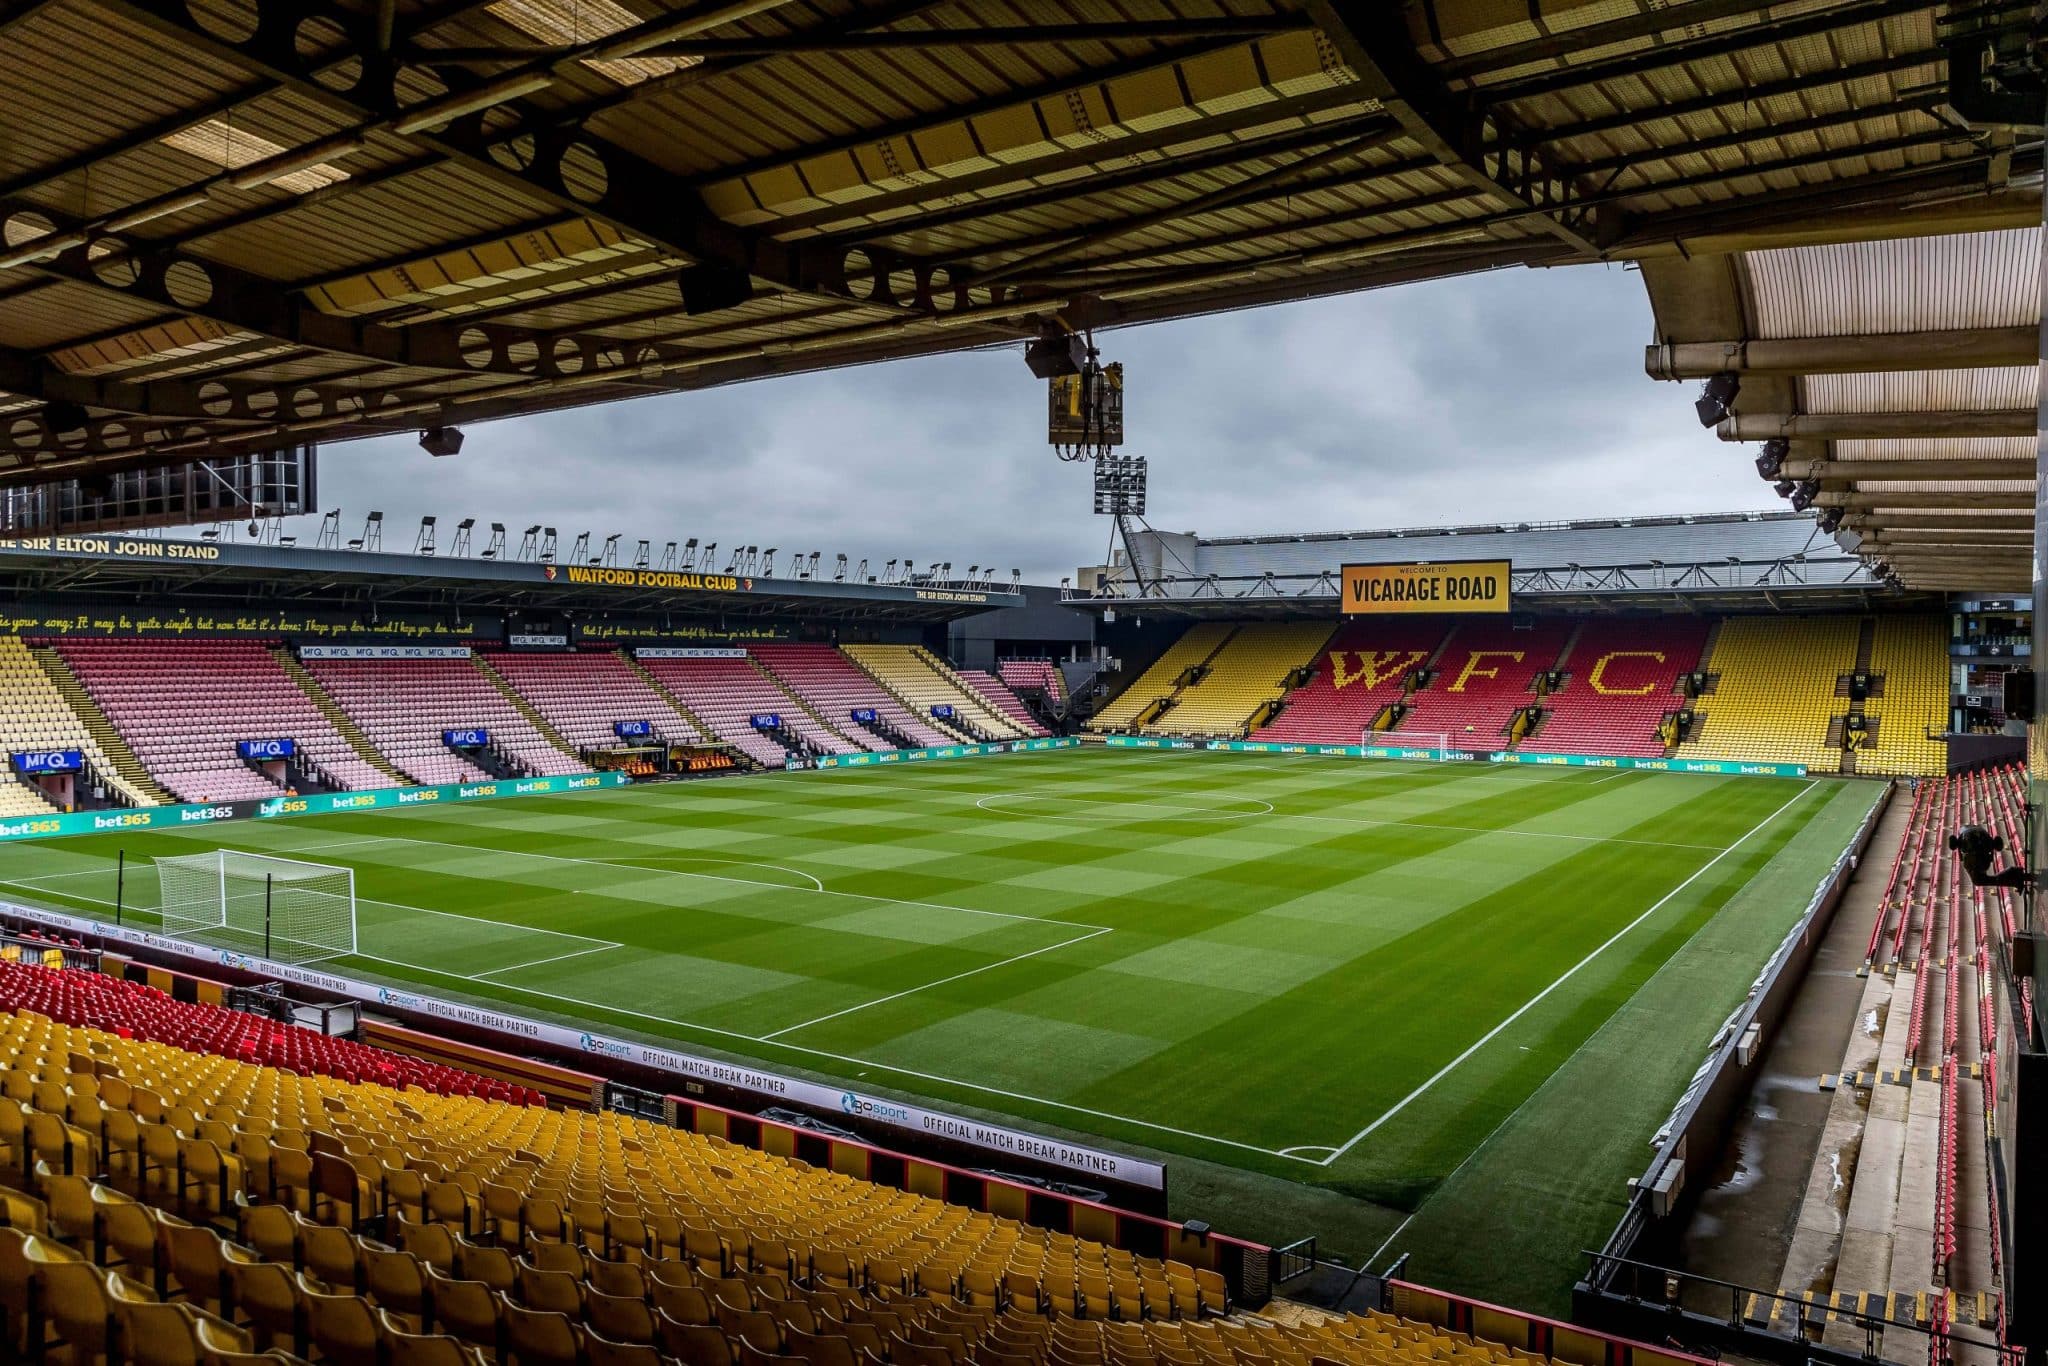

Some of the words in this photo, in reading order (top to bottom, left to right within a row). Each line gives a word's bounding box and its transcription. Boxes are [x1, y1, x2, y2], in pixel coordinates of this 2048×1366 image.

[22, 538, 51, 550] SIR
[57, 538, 110, 554] ELTON
[114, 541, 163, 557] JOHN
[168, 545, 219, 560] STAND
[568, 567, 635, 585] WATFORD
[639, 570, 703, 588] FOOTBALL
[706, 576, 737, 590] CLUB
[1353, 577, 1440, 602] VICARAGE
[1446, 576, 1496, 601] ROAD
[916, 591, 927, 599] THE
[928, 592, 937, 600] SIR
[938, 592, 954, 600] ELTON
[954, 592, 970, 601] JOHN
[970, 593, 987, 602] STAND
[12, 620, 39, 632] your
[76, 616, 88, 629] It
[94, 620, 116, 634] may
[120, 615, 132, 628] be
[136, 616, 162, 633] quite
[164, 617, 194, 634] simple
[197, 617, 214, 630] but
[237, 618, 257, 630] that
[332, 624, 347, 637] you
[304, 649, 324, 657] MrQ
[330, 649, 350, 657] MrQ
[356, 649, 375, 657] MrQ
[381, 649, 400, 657] MrQ
[405, 649, 423, 657] MrQ
[429, 649, 446, 657] MrQ
[451, 649, 468, 657] MrQ
[1329, 652, 1428, 690] W
[1448, 652, 1524, 692] F
[1588, 652, 1666, 695] C
[453, 732, 480, 743] MrQ
[622, 723, 644, 733] MrQ
[250, 741, 284, 756] MrQ
[1244, 744, 1268, 752] bet365
[1402, 751, 1430, 759] bet365
[1585, 759, 1616, 767] bet365
[1635, 761, 1668, 769] bet365
[1687, 763, 1721, 772] bet365
[1741, 765, 1776, 774] bet365
[26, 753, 69, 769] MrQ
[0, 820, 60, 836] bet365
[95, 813, 151, 828] bet365
[182, 806, 233, 821] bet365
[260, 801, 307, 815] bet365
[333, 795, 376, 808] bet365
[400, 791, 439, 803] bet365
[460, 786, 496, 798] bet365
[516, 782, 550, 793] bet365
[569, 777, 600, 788] bet365
[159, 940, 174, 949] BREAK
[174, 943, 194, 955] PARTNER
[260, 963, 282, 975] OFFICIAL
[285, 969, 302, 980] MATCH
[303, 973, 320, 984] BREAK
[322, 978, 346, 991] PARTNER
[386, 993, 419, 1006] gosport
[428, 1003, 456, 1017] OFFICIAL
[459, 1009, 480, 1023] MATCH
[482, 1015, 504, 1028] BREAK
[507, 1020, 538, 1036] PARTNER
[591, 1040, 631, 1055] gosport
[643, 1051, 679, 1069] OFFICIAL
[682, 1061, 710, 1077] MATCH
[714, 1067, 742, 1084] BREAK
[746, 1074, 786, 1094] PARTNER
[855, 1100, 908, 1120] gosport
[924, 1116, 971, 1140] OFFICIAL
[976, 1130, 1013, 1149] MATCH
[1018, 1138, 1056, 1160] BREAK
[1061, 1149, 1117, 1174] PARTNER
